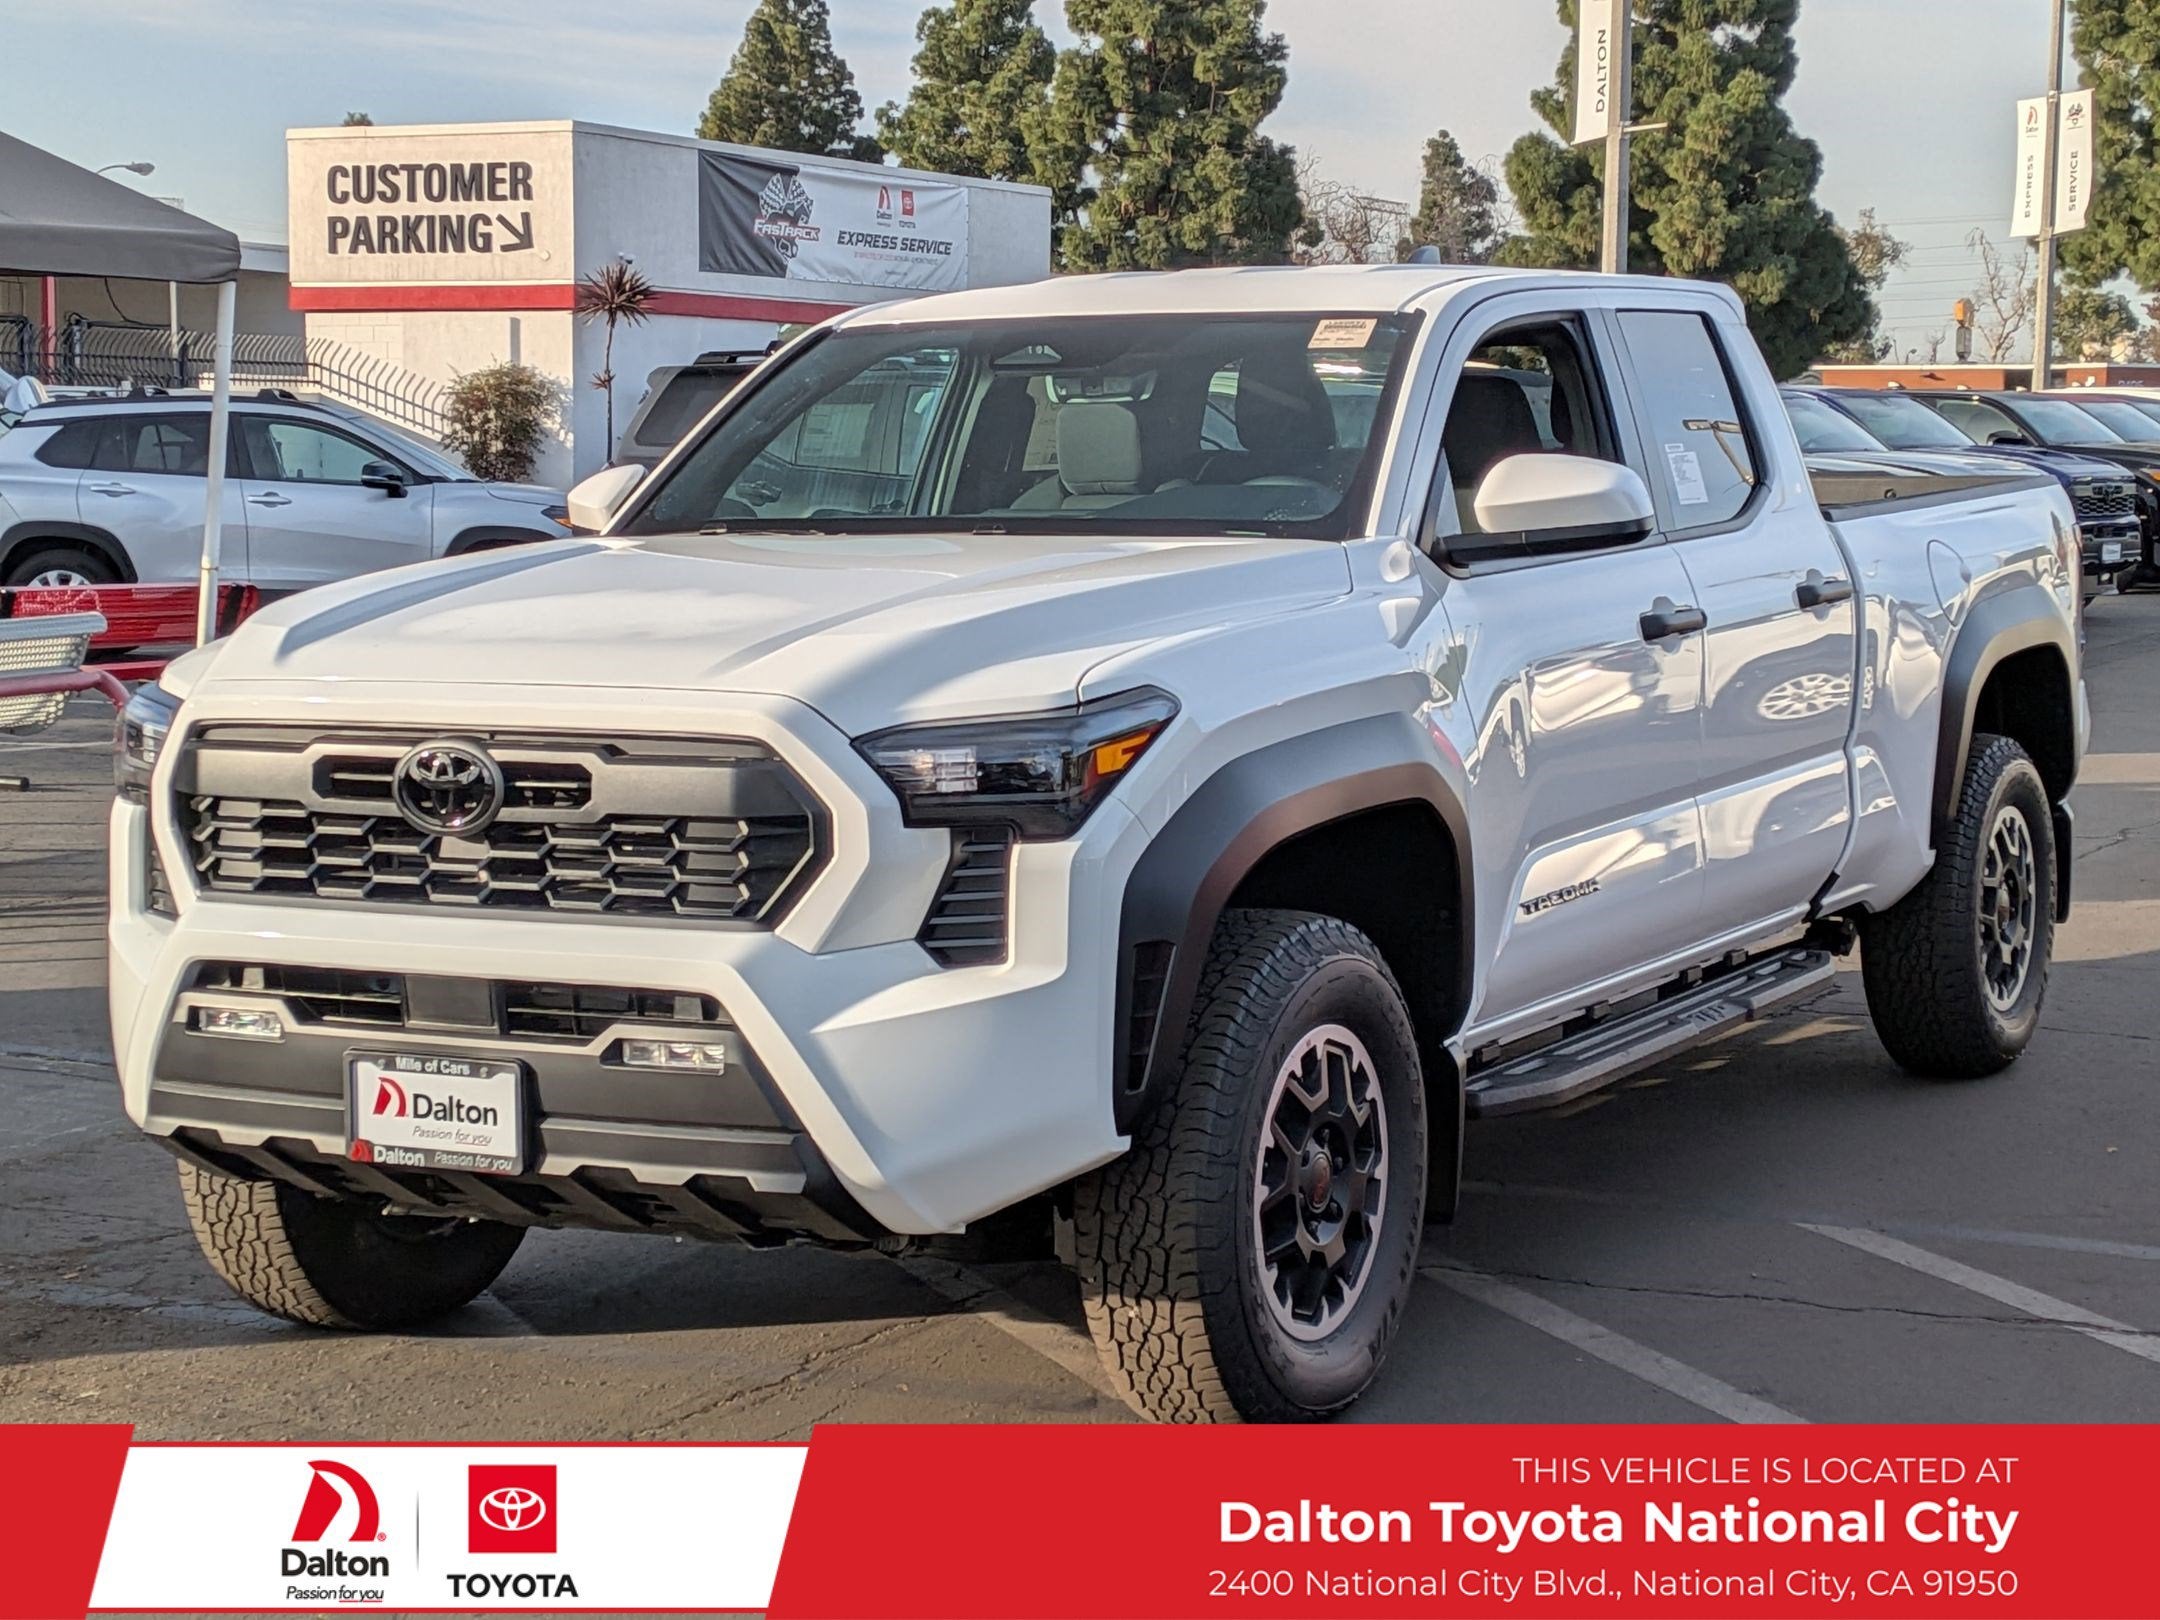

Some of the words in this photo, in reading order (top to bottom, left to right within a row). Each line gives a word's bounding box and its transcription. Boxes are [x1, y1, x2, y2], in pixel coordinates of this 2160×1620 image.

[1595, 29, 1606, 113] DALTON
[327, 161, 534, 204] CUSTOMER
[2068, 150, 2080, 212] SERVICE
[327, 213, 494, 255] PARKING
[837, 230, 898, 250] EXPRESS
[899, 237, 953, 256] SERVICE
[1519, 878, 1600, 916] TACOMA
[395, 1056, 421, 1072] Mile
[425, 1060, 438, 1072] of
[440, 1062, 470, 1076] Cars
[412, 1093, 498, 1127] Dalton
[412, 1125, 452, 1141] Passion
[455, 1129, 470, 1142] for
[472, 1132, 493, 1145] you
[373, 1145, 426, 1168] Dalton
[434, 1151, 474, 1168] Passion
[475, 1154, 492, 1170] for
[492, 1159, 513, 1173] you
